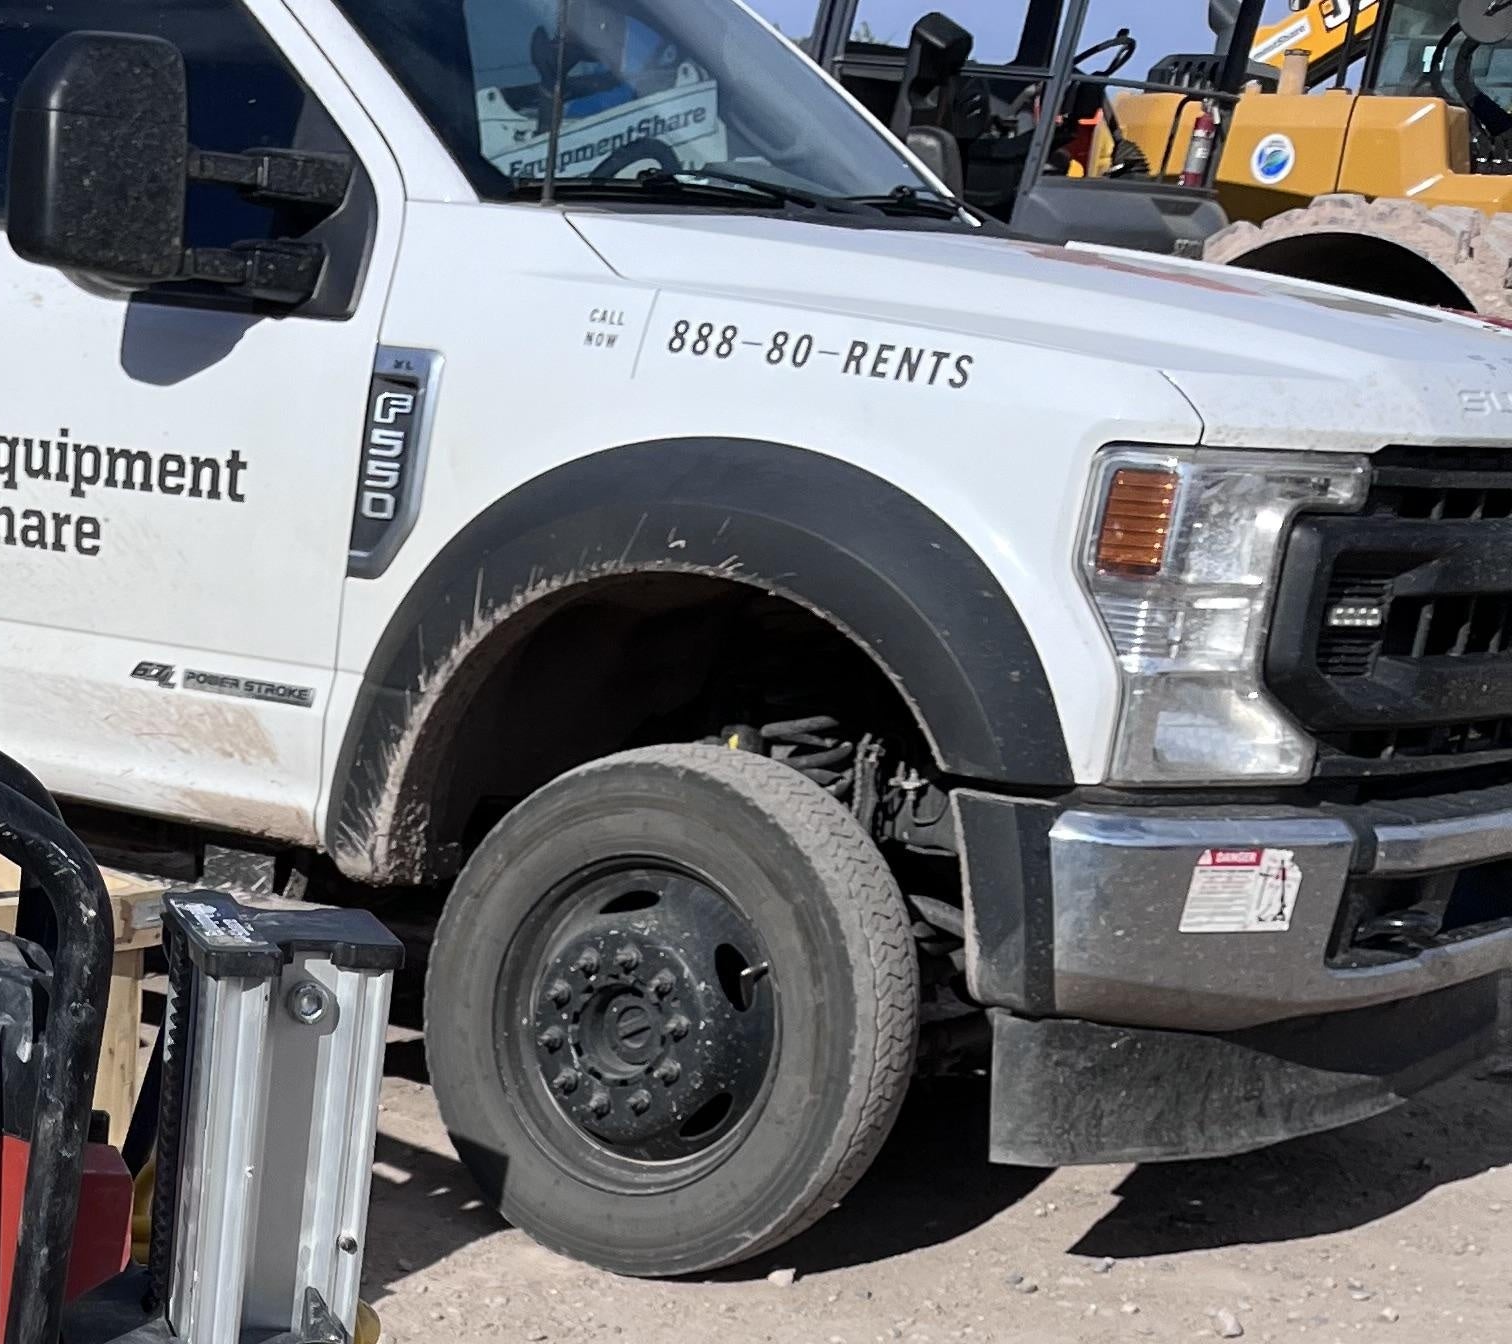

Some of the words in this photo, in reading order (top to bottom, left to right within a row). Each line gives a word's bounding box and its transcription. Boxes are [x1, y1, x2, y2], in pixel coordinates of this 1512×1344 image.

[509, 106, 706, 178] EqupmentShare
[589, 308, 625, 326] CALL
[584, 331, 619, 348] NOW
[667, 319, 975, 390] 888-80-RENTS
[244, 680, 309, 699] STROKE
